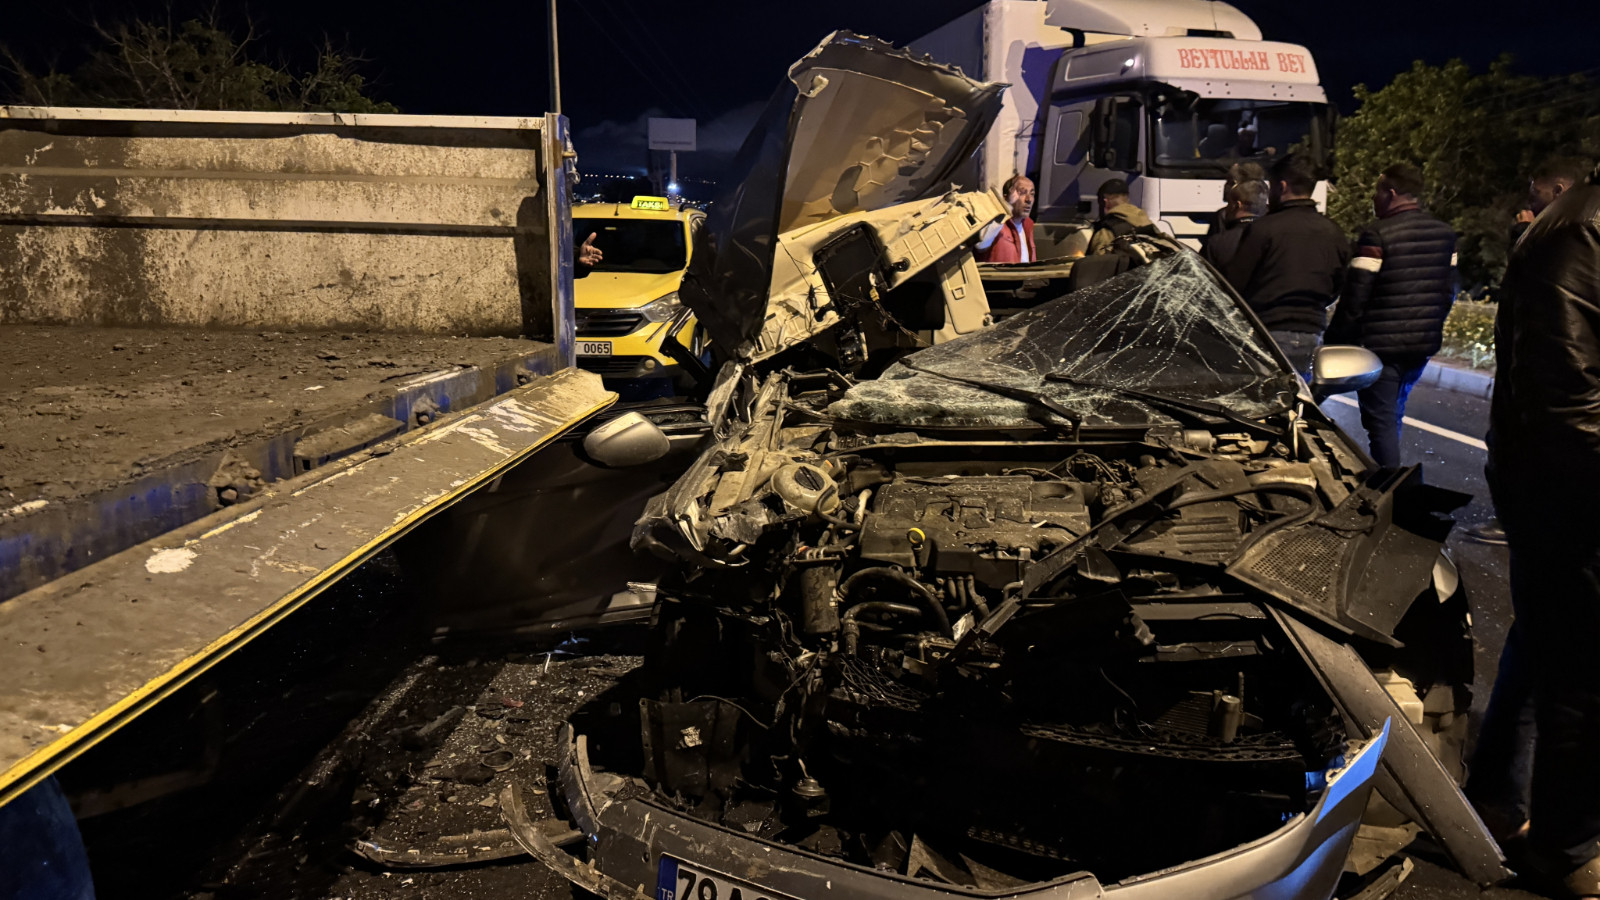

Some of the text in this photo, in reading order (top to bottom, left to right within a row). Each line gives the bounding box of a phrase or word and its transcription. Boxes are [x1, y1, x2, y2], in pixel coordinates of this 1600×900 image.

[1178, 48, 1306, 73] BEYTULLAH BEY
[584, 343, 610, 354] 0065
[661, 888, 674, 900] TR
